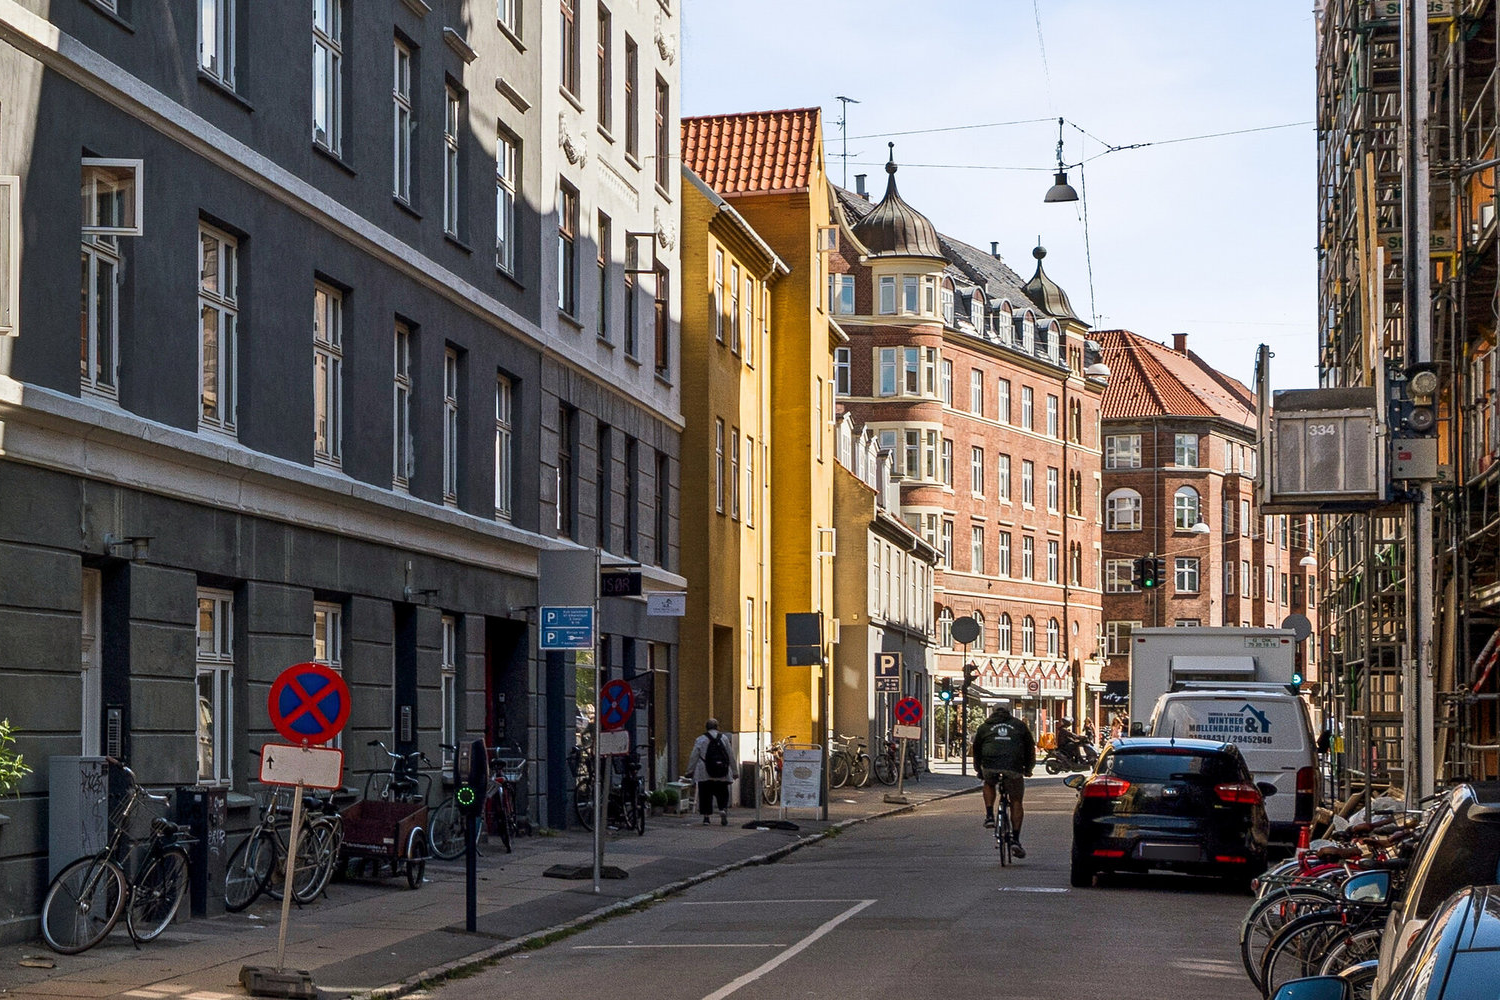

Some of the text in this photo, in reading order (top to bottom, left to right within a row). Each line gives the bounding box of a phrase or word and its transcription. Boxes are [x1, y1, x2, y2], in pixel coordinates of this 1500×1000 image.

[1309, 425, 1335, 436] 334
[547, 612, 555, 623] P
[547, 632, 556, 643] P
[881, 656, 895, 675] P
[1208, 717, 1244, 725] WINTHER
